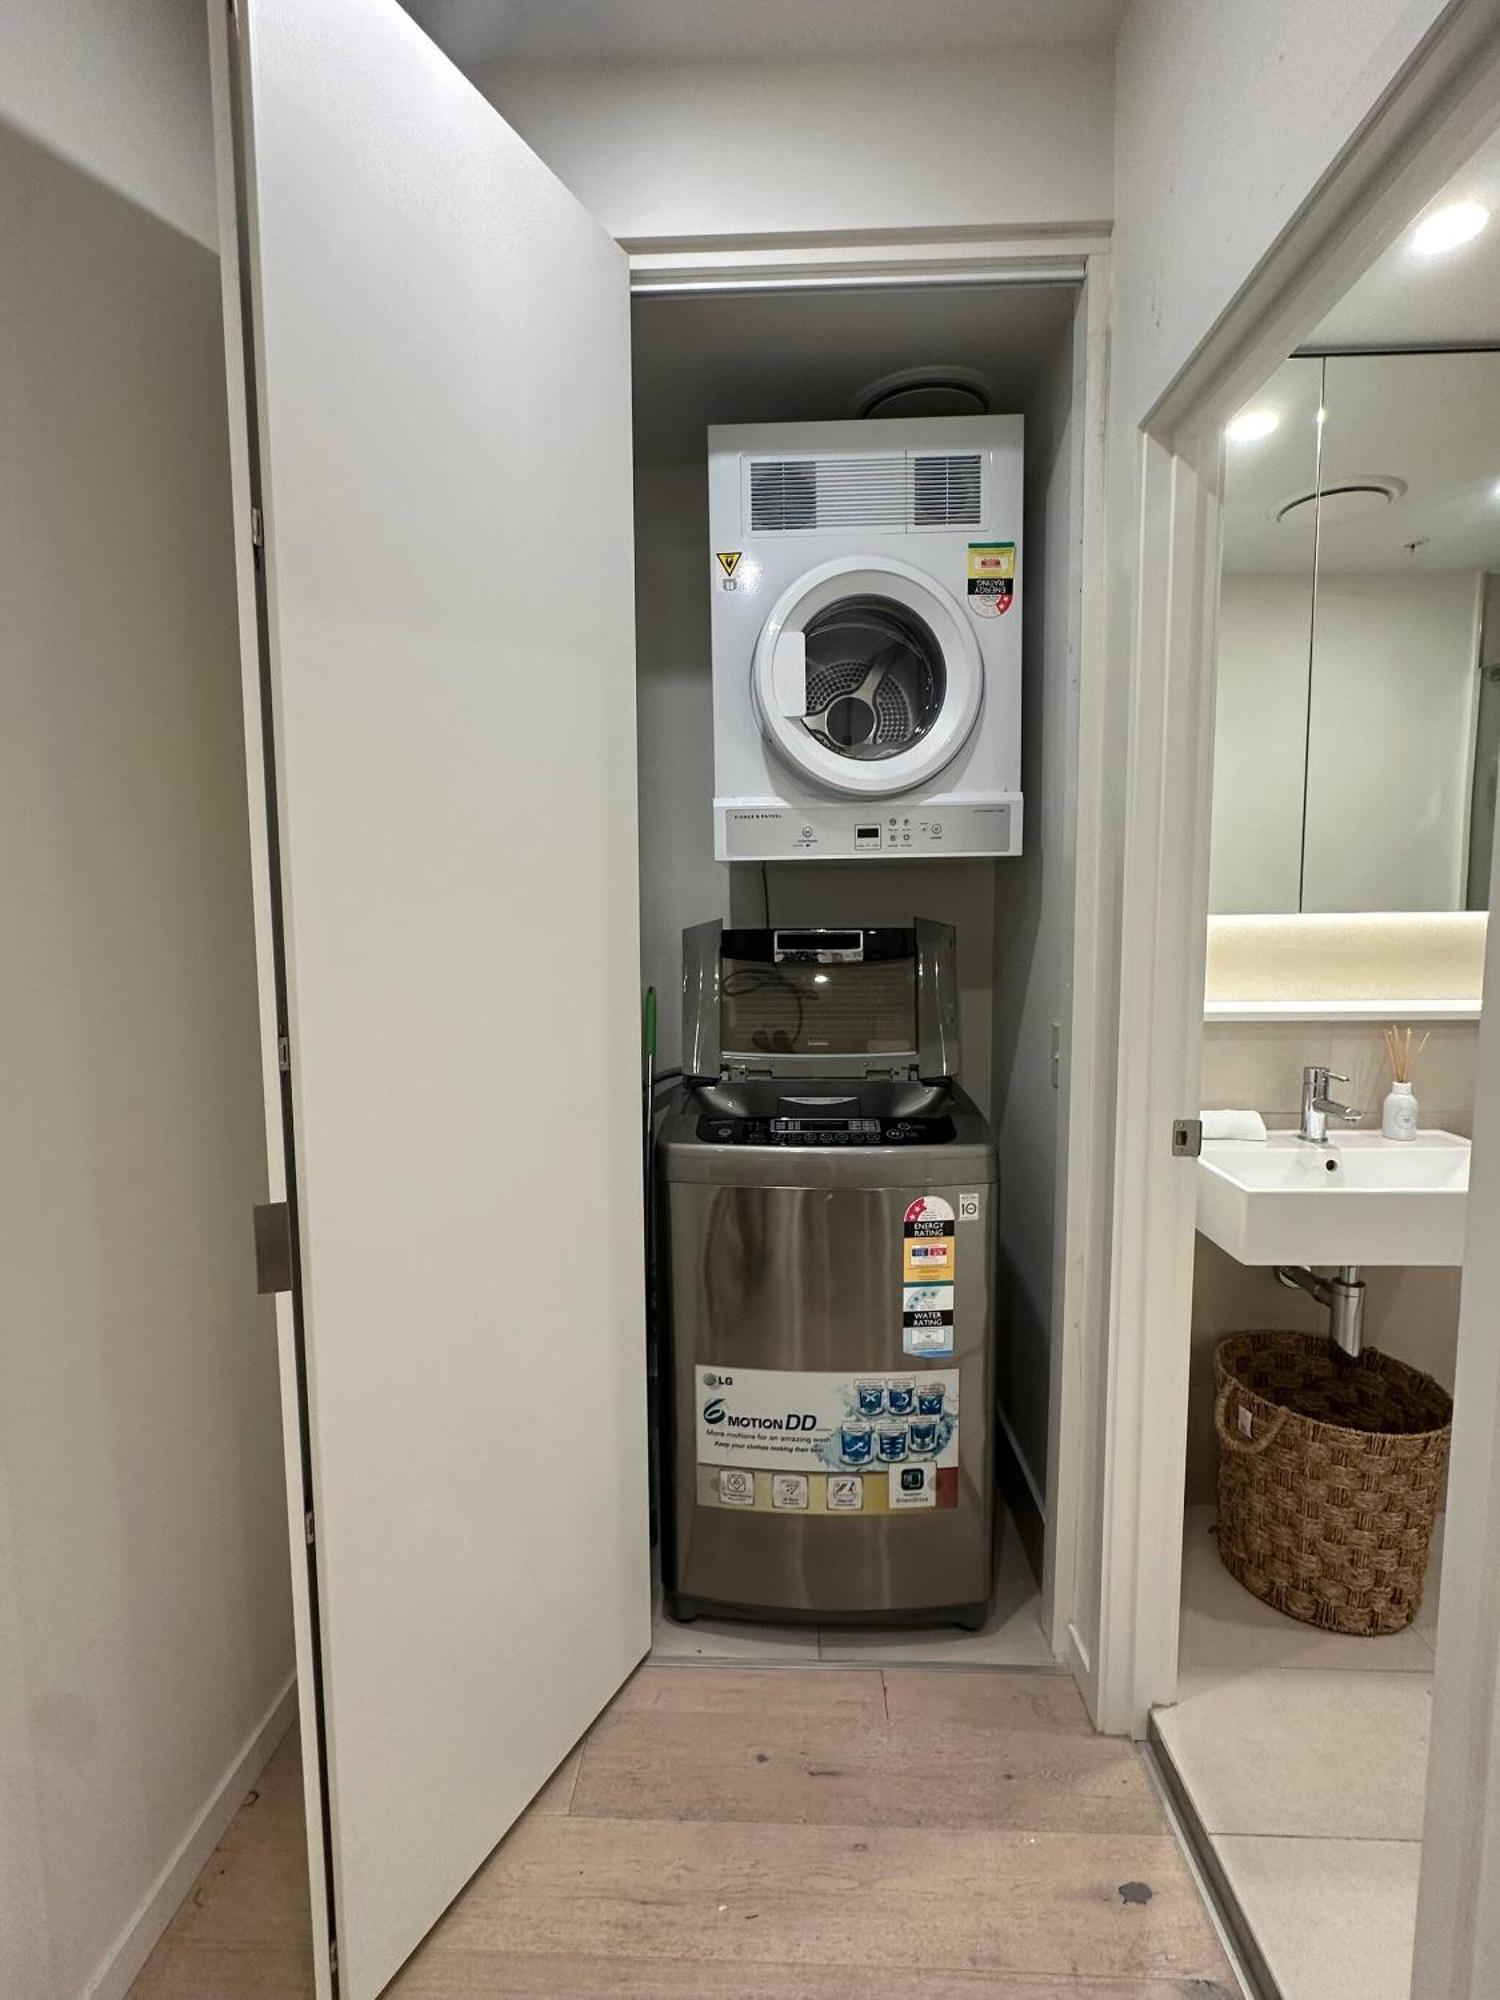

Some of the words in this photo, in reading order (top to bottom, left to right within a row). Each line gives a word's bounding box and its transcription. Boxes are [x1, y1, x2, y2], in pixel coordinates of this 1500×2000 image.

[914, 1222, 944, 1230] ENERGY
[914, 1229, 944, 1237] RATING
[914, 1311, 942, 1319] WATER
[718, 1376, 733, 1386] LG
[728, 1415, 783, 1430] MOTION
[785, 1414, 817, 1431] DD
[706, 1428, 725, 1437] More
[781, 1435, 812, 1444] amazing
